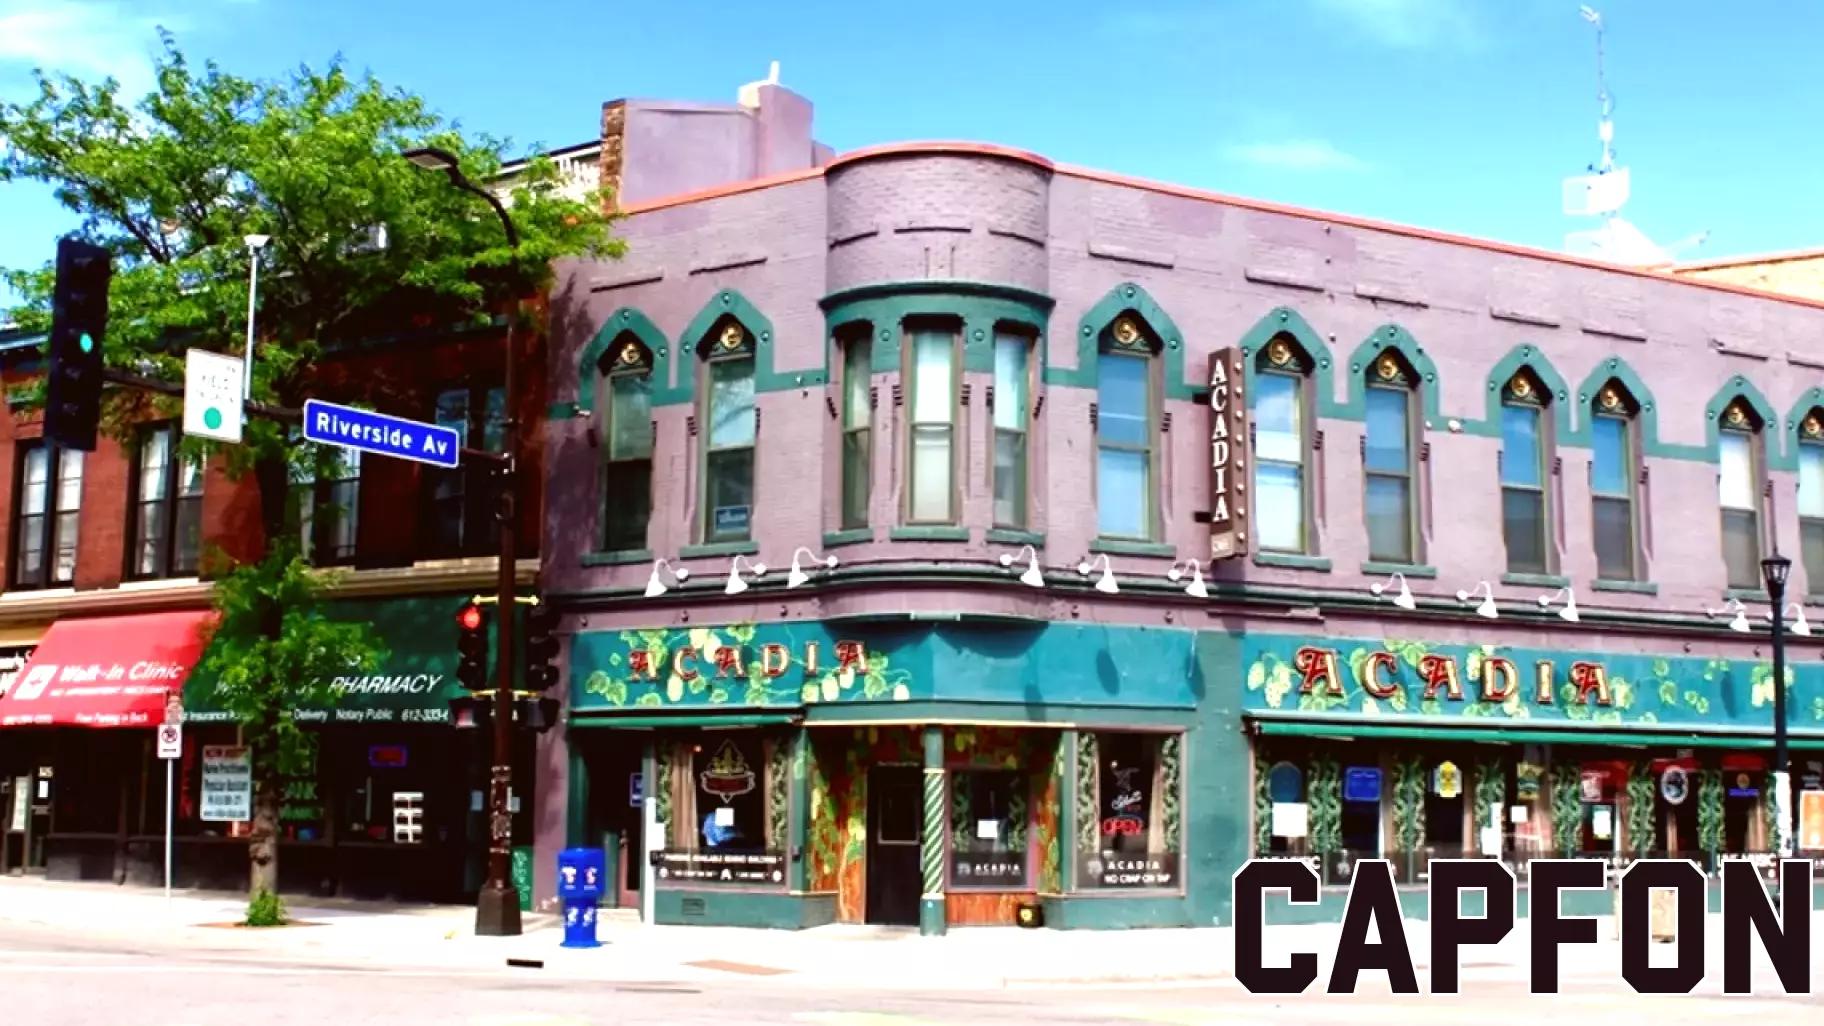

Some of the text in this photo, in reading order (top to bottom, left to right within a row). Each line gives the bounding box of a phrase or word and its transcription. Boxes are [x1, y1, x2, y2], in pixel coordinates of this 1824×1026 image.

[316, 411, 448, 456] Riverside Av
[1211, 358, 1230, 522] ACADIA
[129, 660, 185, 681] Clinic
[627, 639, 868, 681] ACADIA
[327, 673, 443, 694] PHARMACY
[1295, 647, 1613, 706] ACADIA
[366, 708, 393, 721] Public
[1102, 816, 1145, 837] OPEN
[1107, 860, 1161, 871] ACADIA
